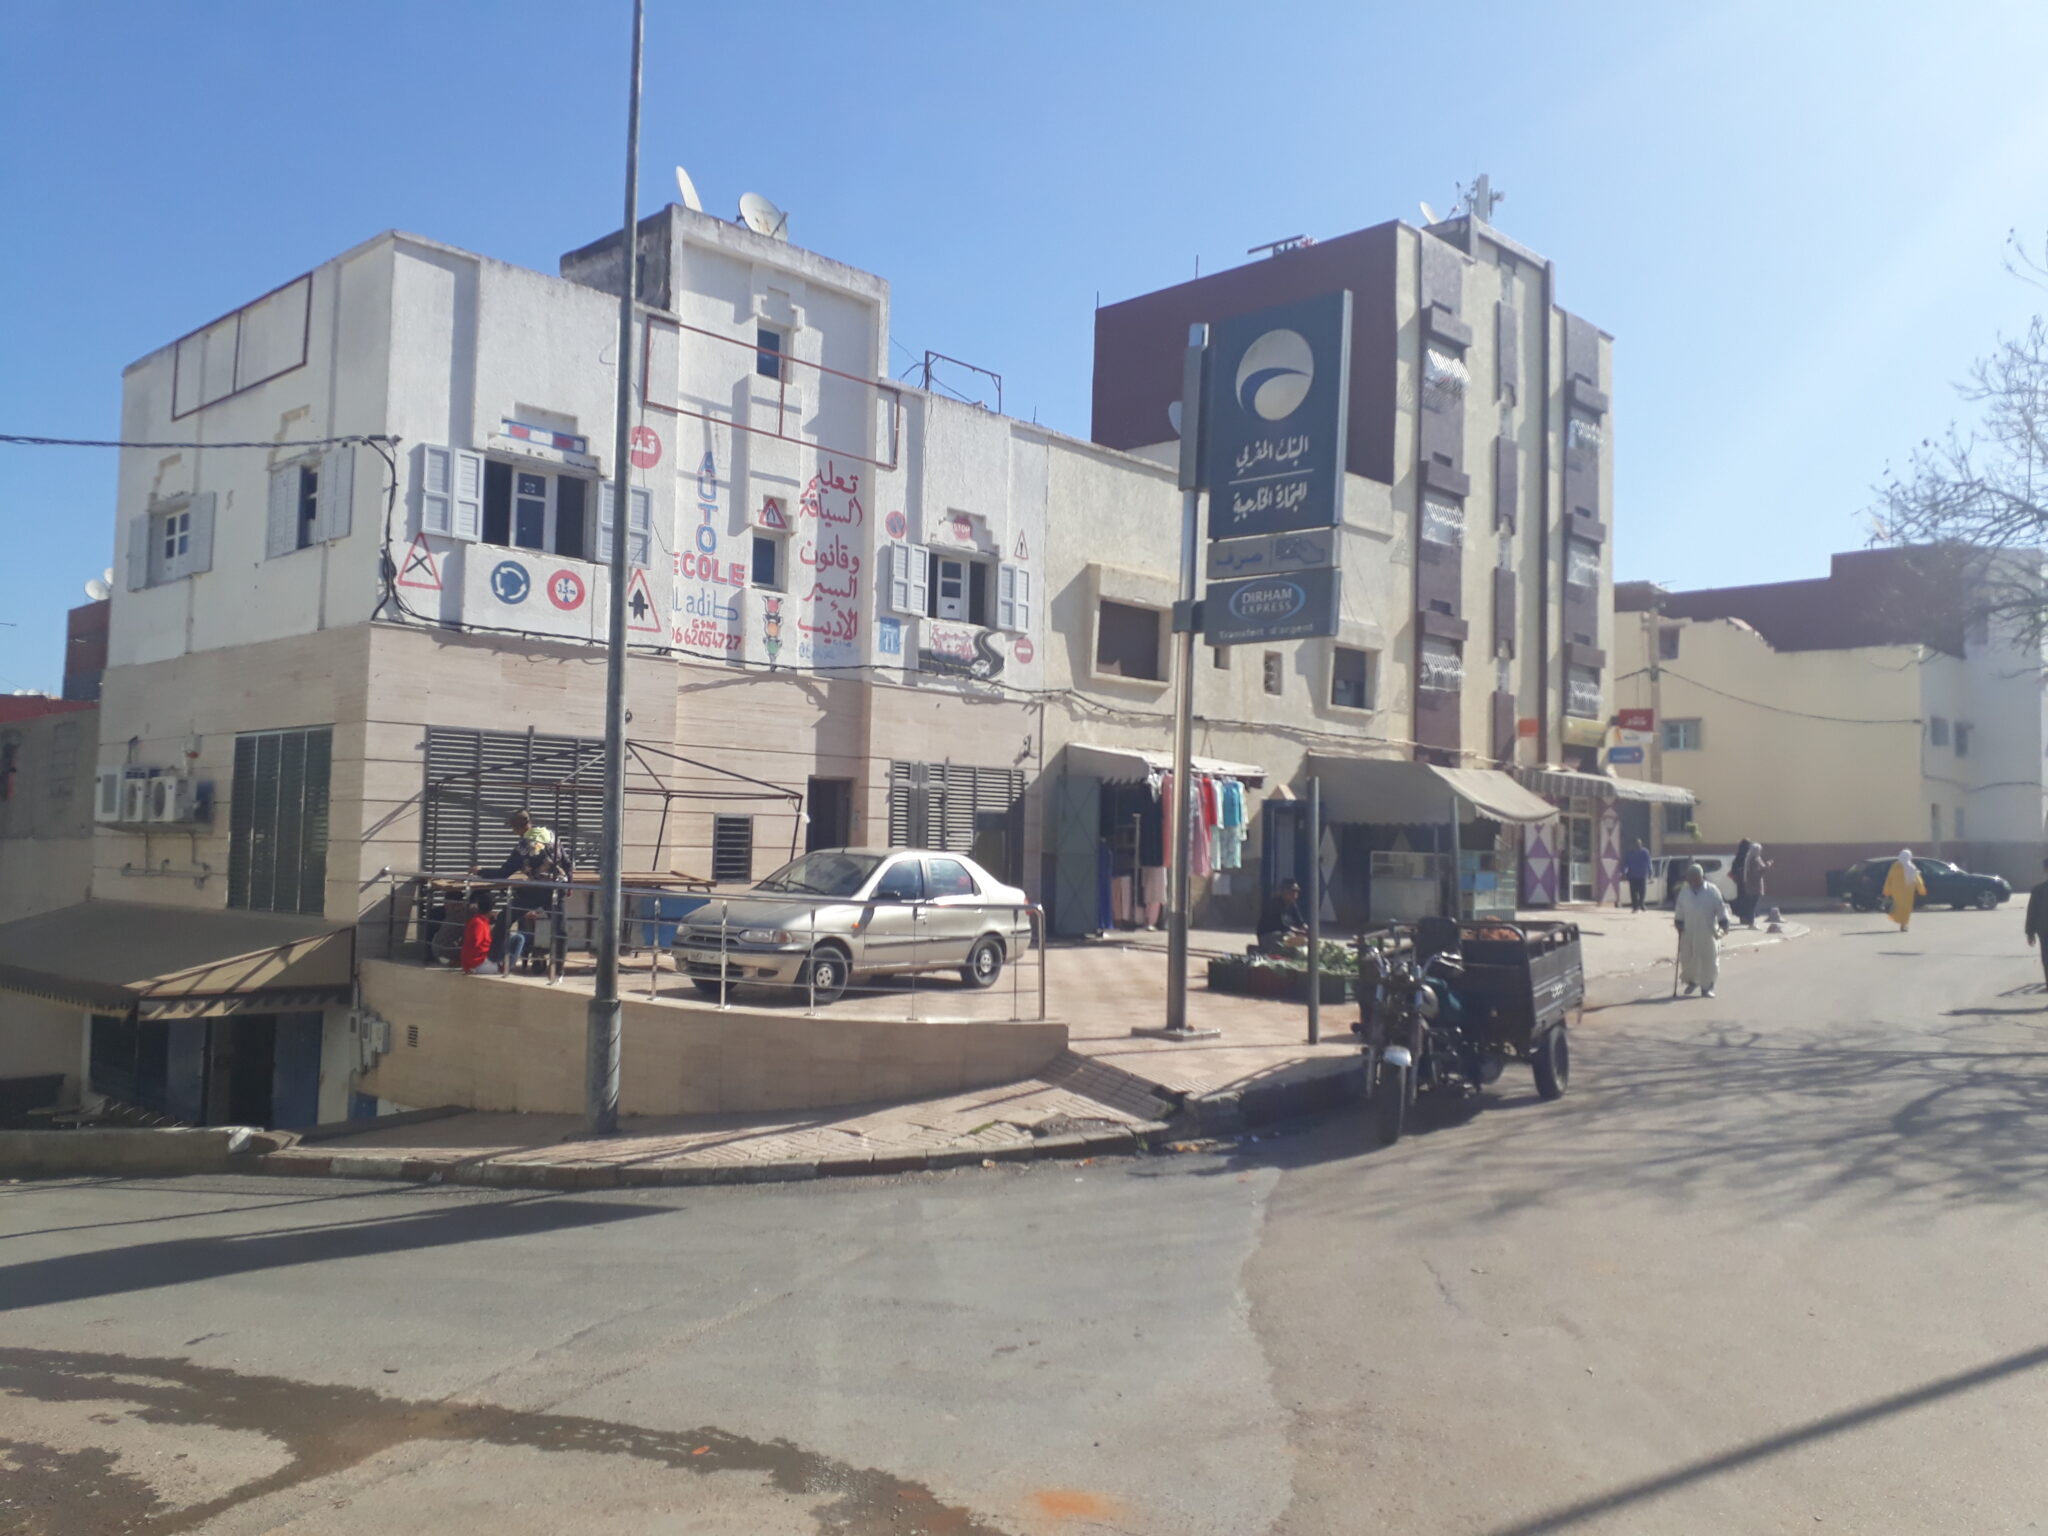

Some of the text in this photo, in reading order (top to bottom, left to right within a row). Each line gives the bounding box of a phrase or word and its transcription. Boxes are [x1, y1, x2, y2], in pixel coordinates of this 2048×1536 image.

[1235, 434, 1310, 475] البنك المغربي
[800, 461, 860, 498] تعليم
[697, 450, 718, 556] AUTO
[800, 494, 864, 528] السياقة
[1232, 480, 1308, 523] للتجارة الخارجية
[800, 535, 861, 576] وقانون
[803, 575, 858, 603] السير
[1241, 587, 1293, 604] DIRHAM
[797, 600, 859, 645] الأديب
[1241, 602, 1292, 615] EXPRESS
[1218, 623, 1313, 640] Transfert d'argent
